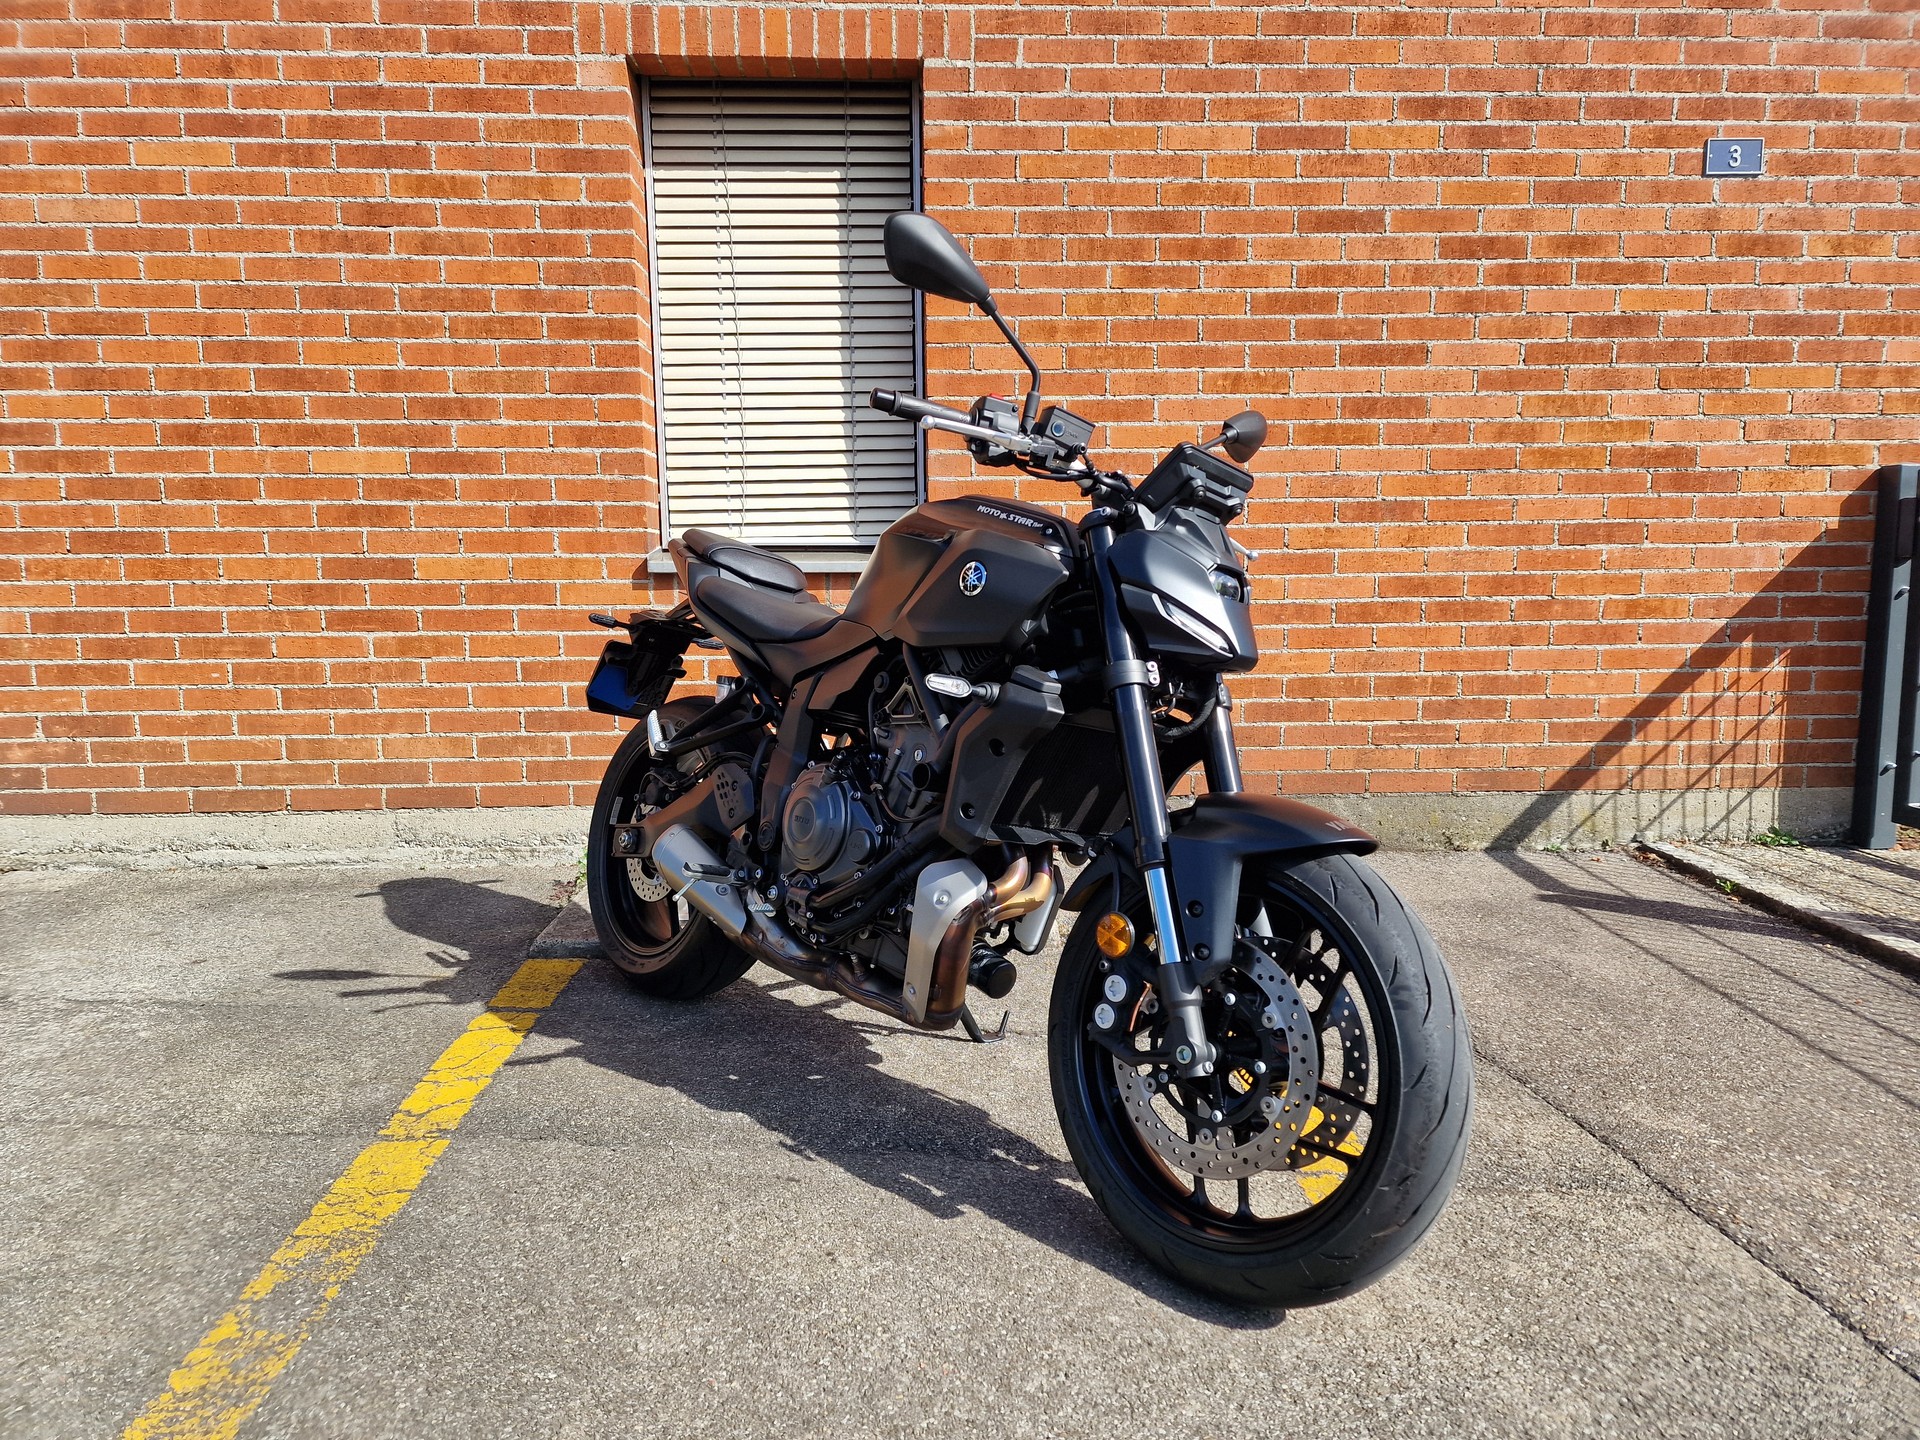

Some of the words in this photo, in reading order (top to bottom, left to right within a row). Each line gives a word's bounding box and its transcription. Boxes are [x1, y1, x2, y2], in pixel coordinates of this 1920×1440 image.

[1728, 145, 1742, 168] 3
[977, 505, 1001, 517] MOTO
[1008, 513, 1034, 527] STAR
